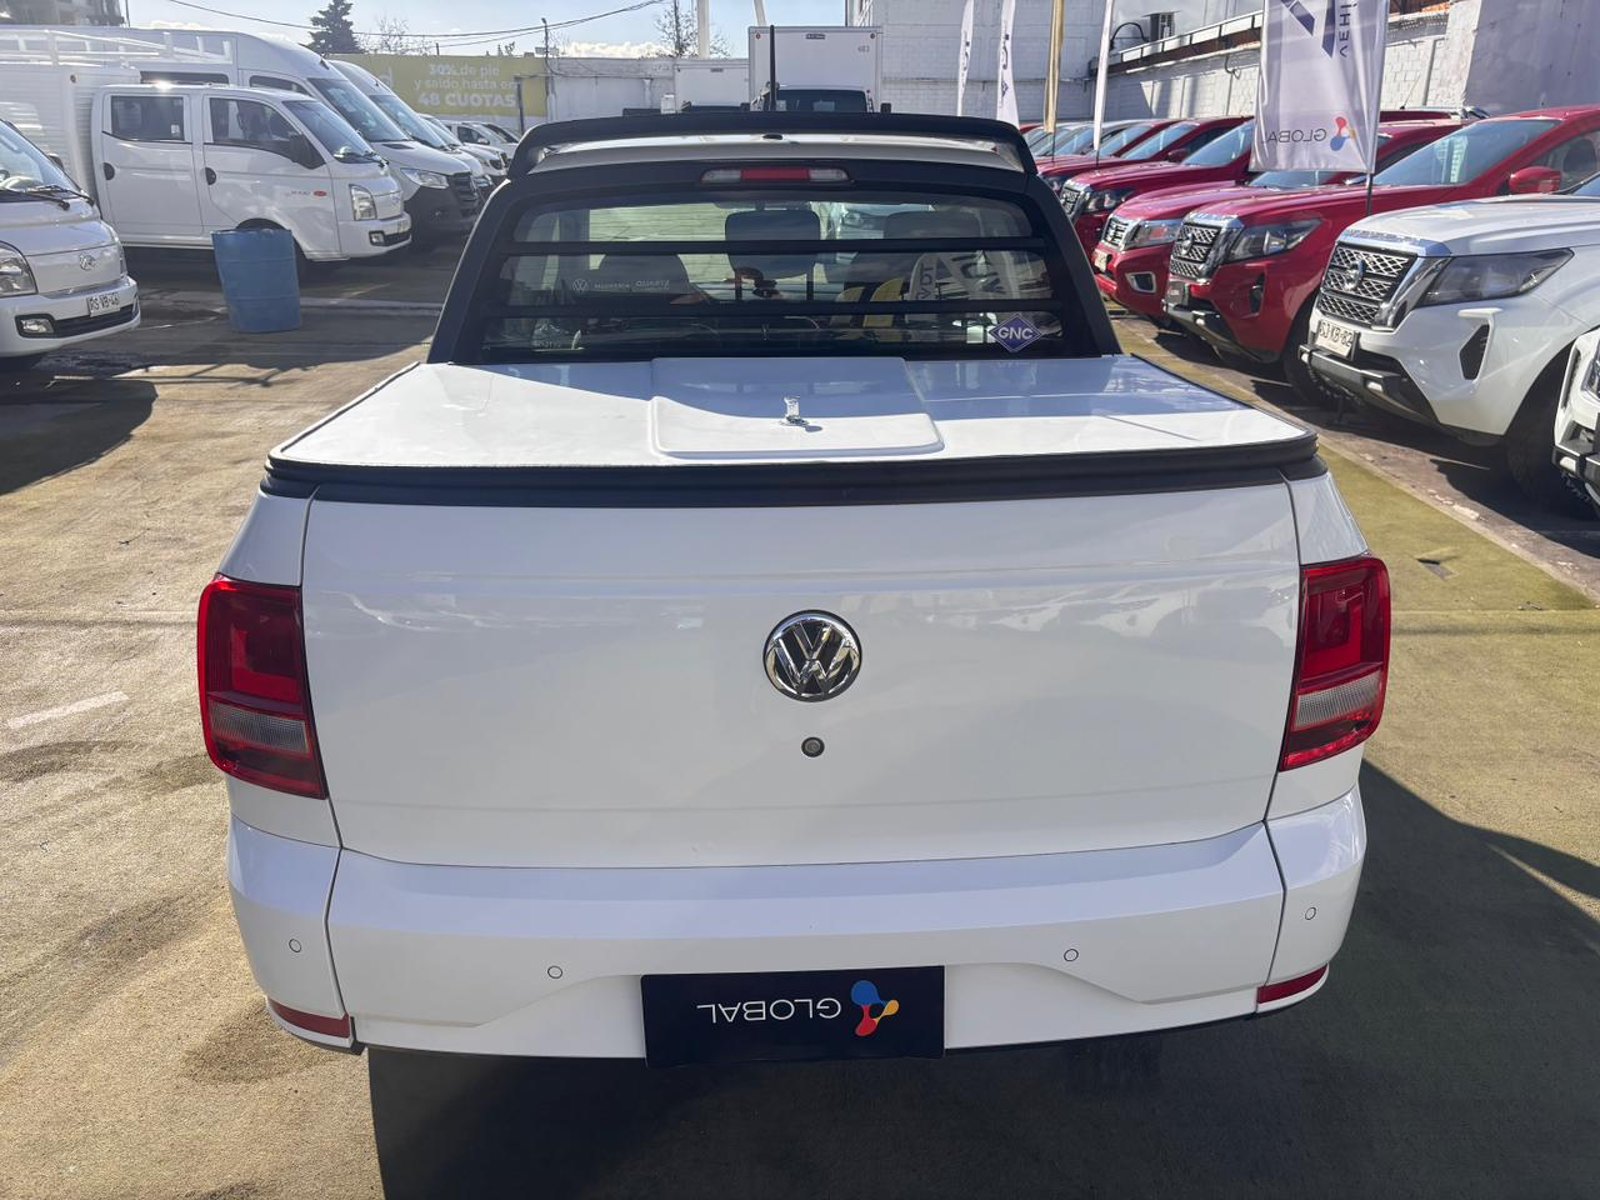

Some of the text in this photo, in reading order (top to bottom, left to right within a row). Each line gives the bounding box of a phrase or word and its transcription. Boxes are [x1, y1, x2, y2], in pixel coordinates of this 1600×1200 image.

[445, 94, 517, 107] CUOTAS
[997, 327, 1034, 340] GNC
[697, 997, 842, 1024] GLOBAL
